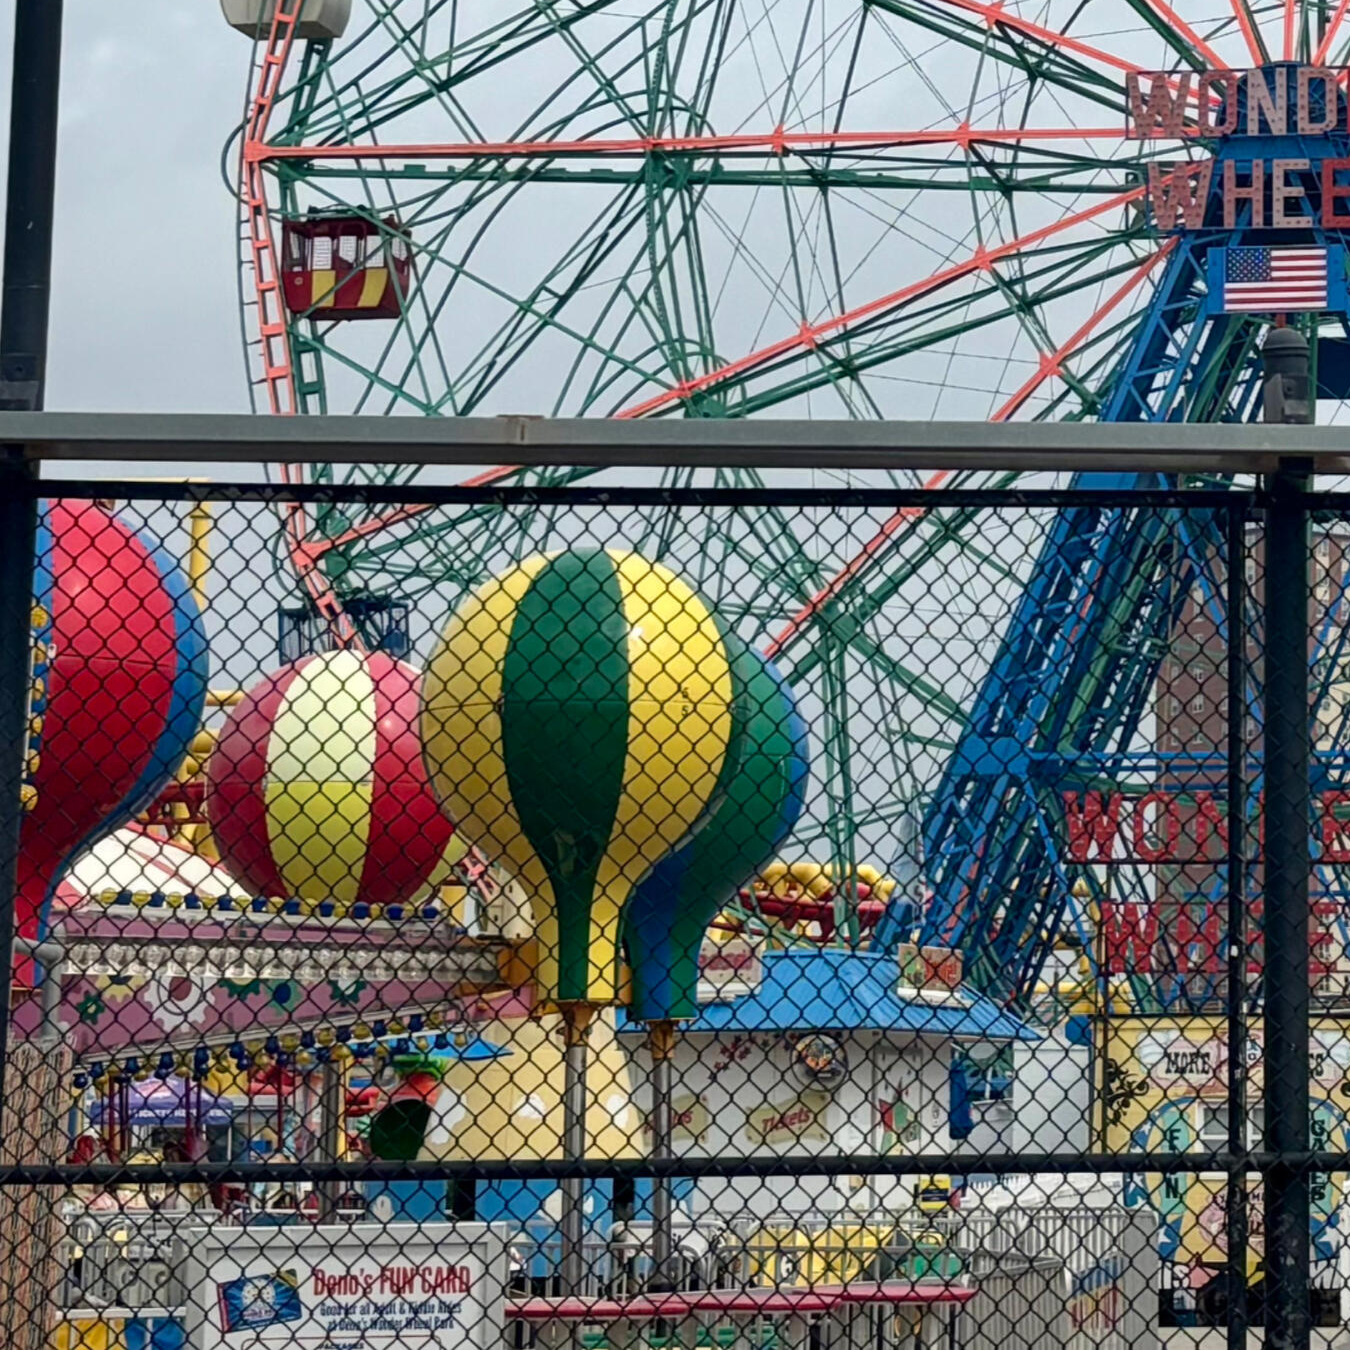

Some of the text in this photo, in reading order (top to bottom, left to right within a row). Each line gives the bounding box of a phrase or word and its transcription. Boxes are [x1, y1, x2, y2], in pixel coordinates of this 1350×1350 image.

[313, 1265, 470, 1296] Deno's FUN CARD
